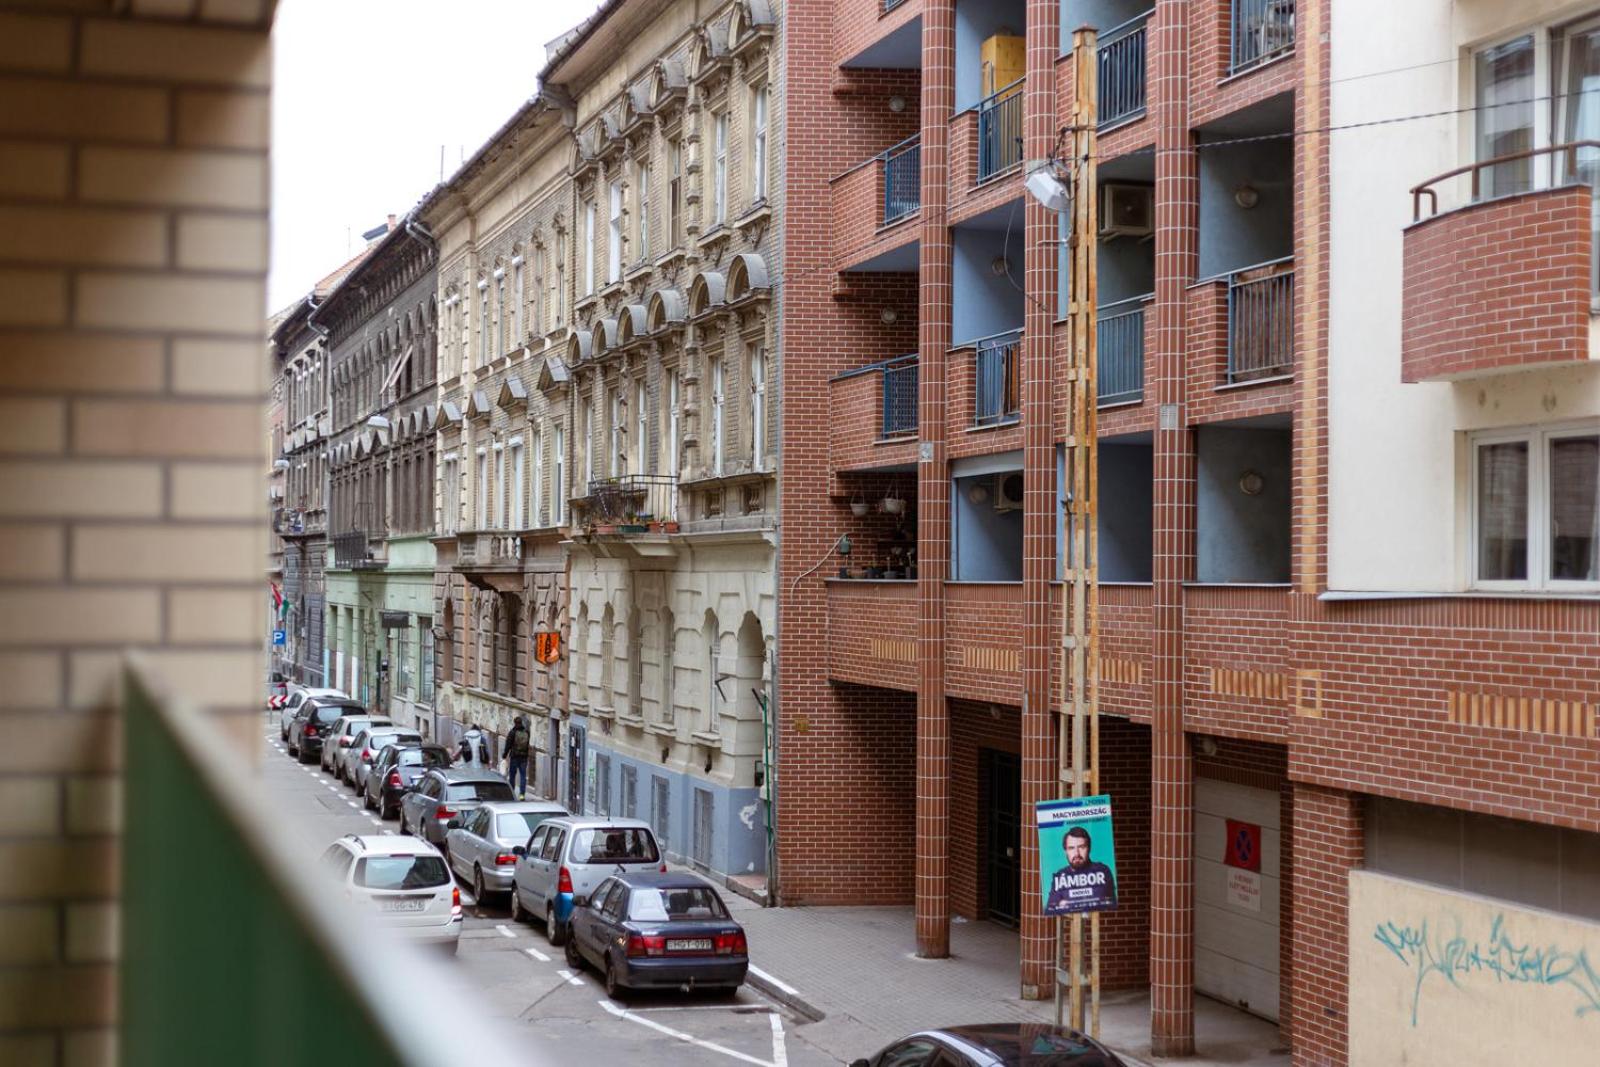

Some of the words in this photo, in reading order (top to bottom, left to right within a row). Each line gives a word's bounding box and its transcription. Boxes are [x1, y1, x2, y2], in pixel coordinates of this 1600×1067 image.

[273, 632, 284, 643] P
[1052, 807, 1107, 819] MAGYARORSZÁG
[1054, 872, 1106, 891] JÁMBOR
